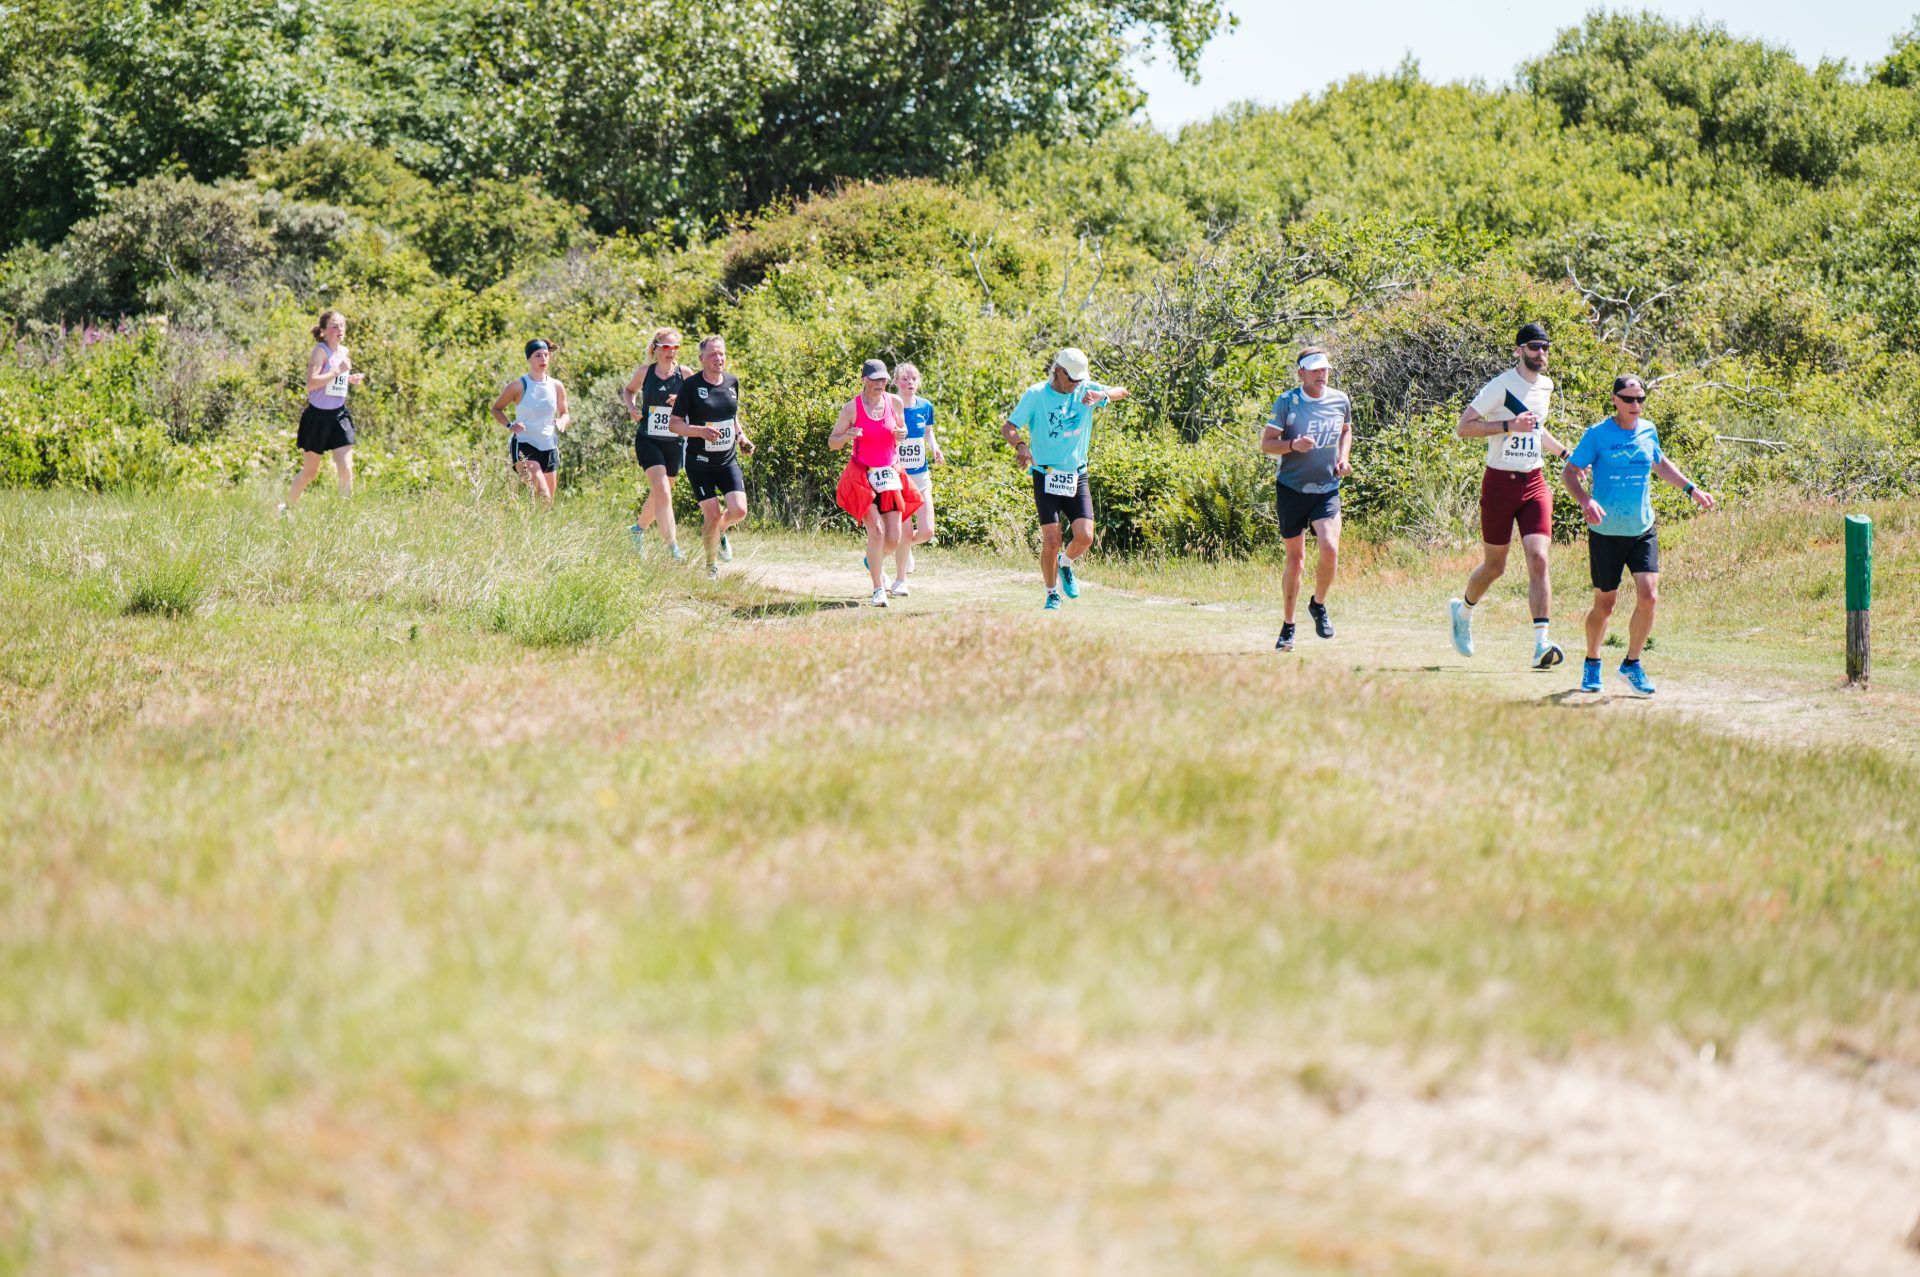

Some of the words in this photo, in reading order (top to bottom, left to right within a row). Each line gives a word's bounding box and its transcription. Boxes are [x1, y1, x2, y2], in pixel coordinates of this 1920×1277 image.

[654, 413, 672, 425] 38
[1306, 418, 1342, 433] EWE
[717, 427, 731, 440] 60
[1510, 436, 1534, 450] 311
[899, 444, 920, 456] 659
[1504, 449, 1539, 458] Sven-Ole
[873, 469, 894, 481] 165
[1051, 472, 1074, 484] 355
[1049, 482, 1076, 492] Norbert
